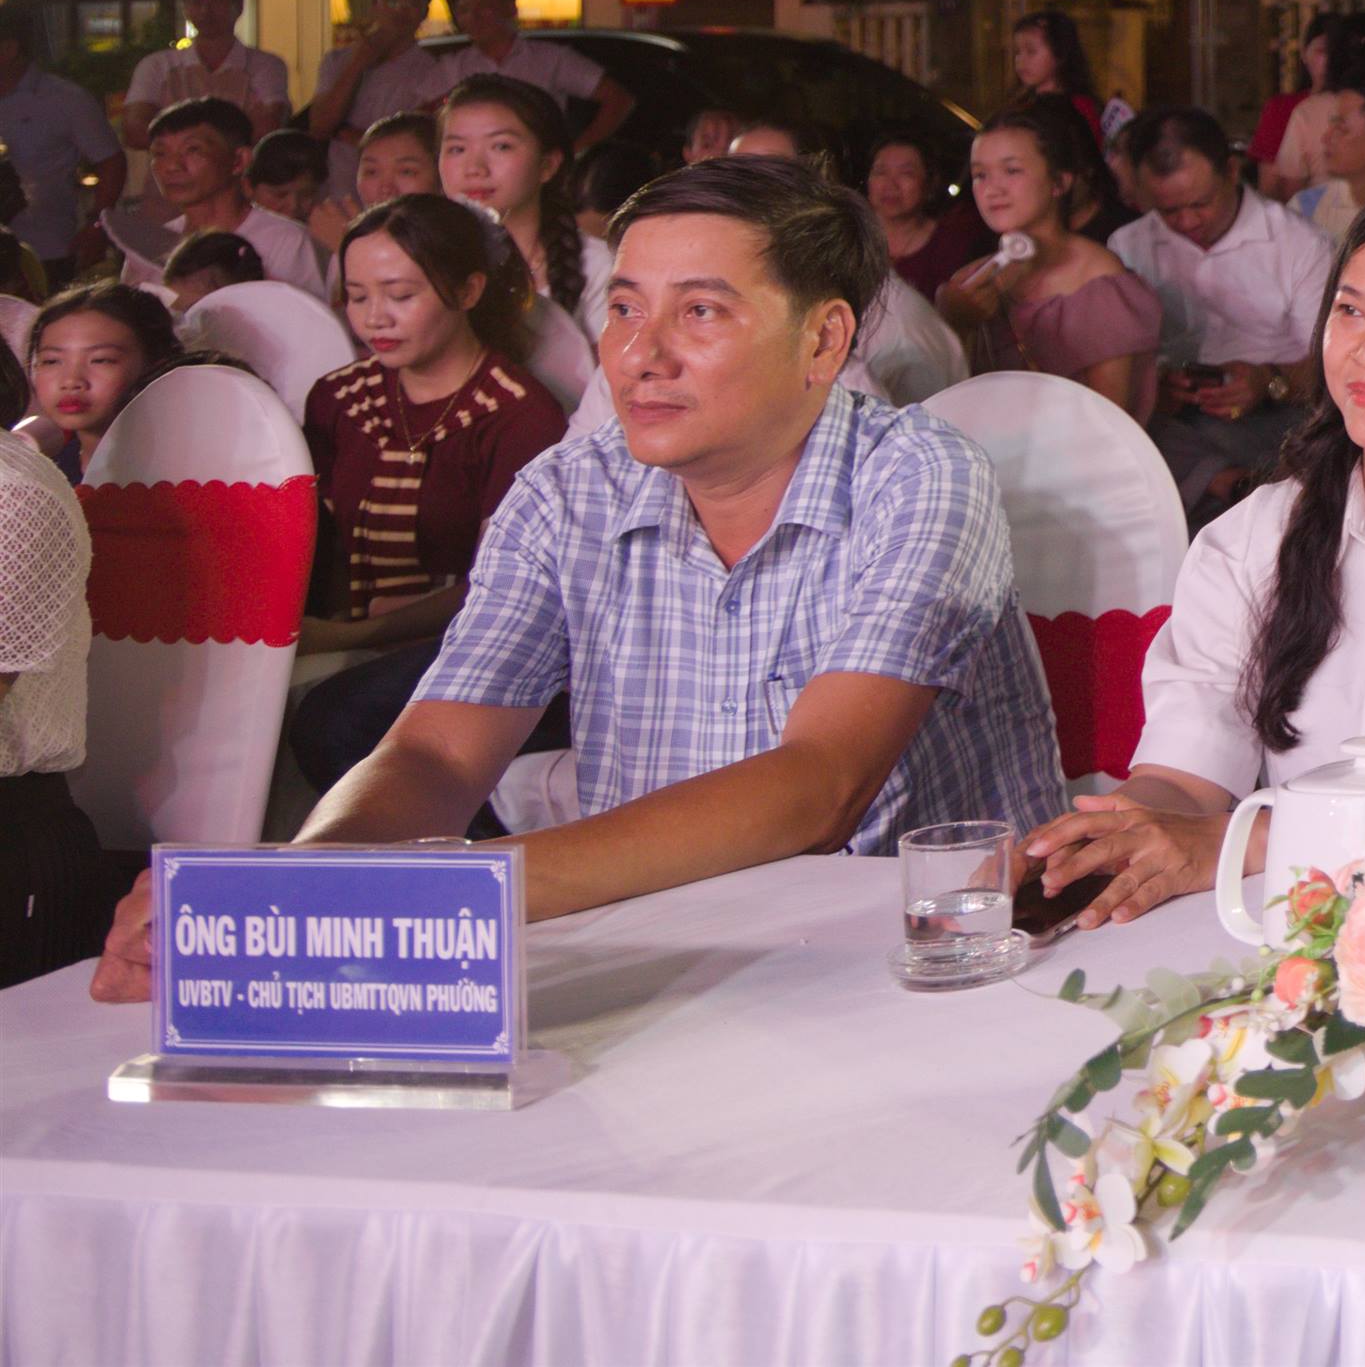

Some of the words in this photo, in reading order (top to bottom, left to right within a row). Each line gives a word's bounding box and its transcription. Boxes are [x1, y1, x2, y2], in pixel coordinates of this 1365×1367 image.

[175, 904, 237, 958] ÔNG
[245, 905, 296, 958] BÙI
[306, 916, 384, 959] MINH
[393, 907, 498, 969] THUẬN
[178, 979, 233, 1008] UVBTV
[248, 971, 283, 1009] CHỦ
[284, 980, 326, 1015] TỊCH
[329, 982, 423, 1015] UBMTTQVN
[426, 978, 498, 1014] PHƯỜNG
